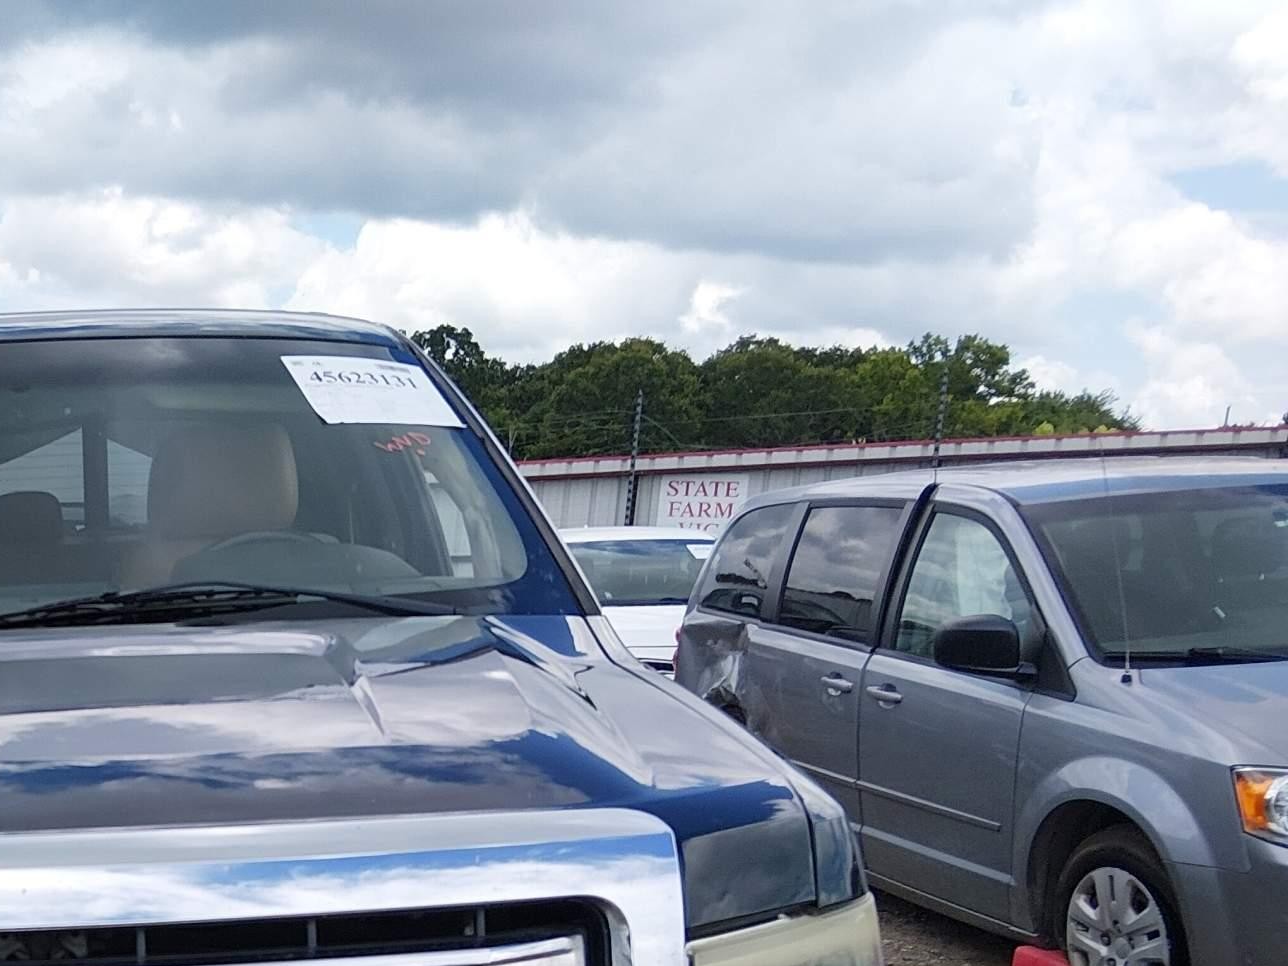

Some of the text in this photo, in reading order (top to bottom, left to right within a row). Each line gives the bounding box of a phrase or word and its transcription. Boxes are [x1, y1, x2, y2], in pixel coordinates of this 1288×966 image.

[310, 371, 417, 389] 45623131
[666, 480, 740, 497] STATE
[668, 501, 734, 519] FARM
